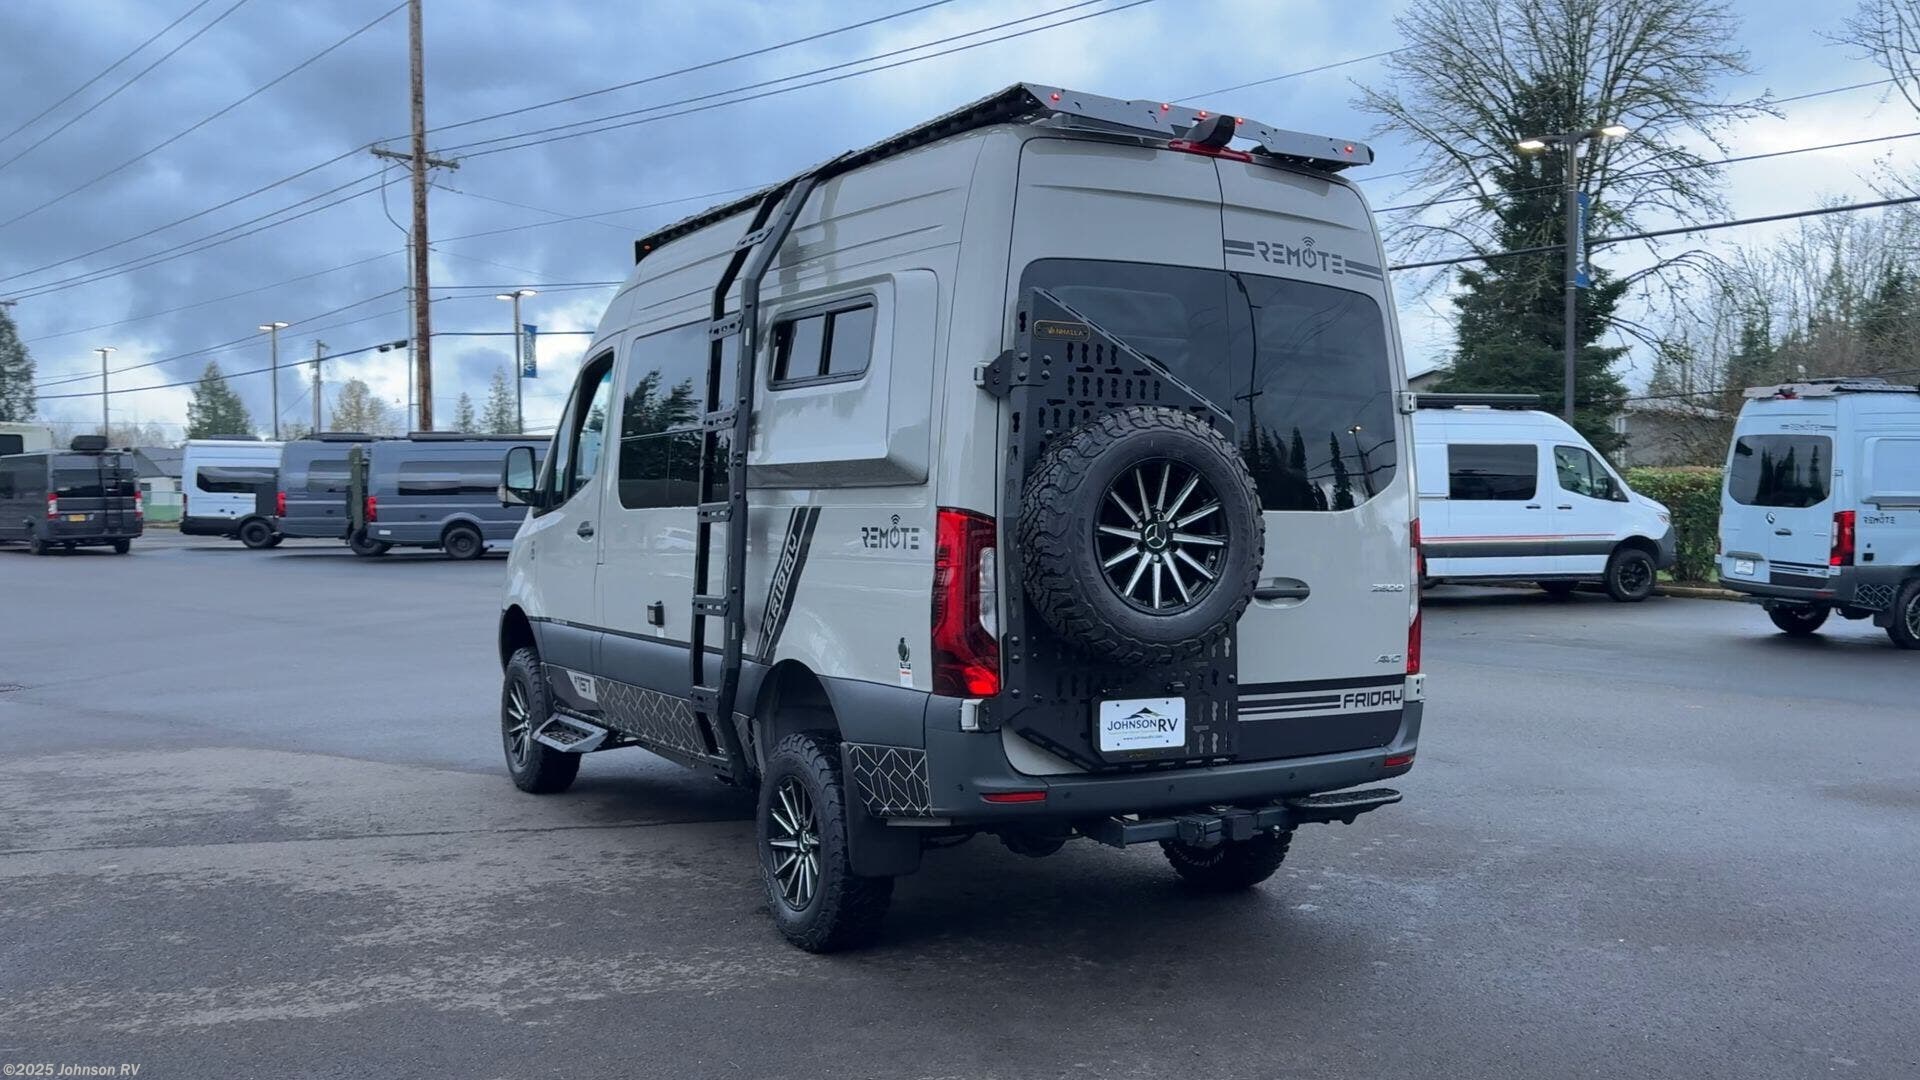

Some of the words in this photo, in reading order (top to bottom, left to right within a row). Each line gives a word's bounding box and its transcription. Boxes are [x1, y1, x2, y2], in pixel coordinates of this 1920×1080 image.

[1256, 238, 1344, 275] REMOTE
[861, 525, 920, 550] REMOTE
[766, 534, 797, 635] FRIDAY
[1343, 689, 1403, 709] FRIDAY
[1107, 719, 1157, 731] JOHNSON
[1158, 718, 1178, 732] RV
